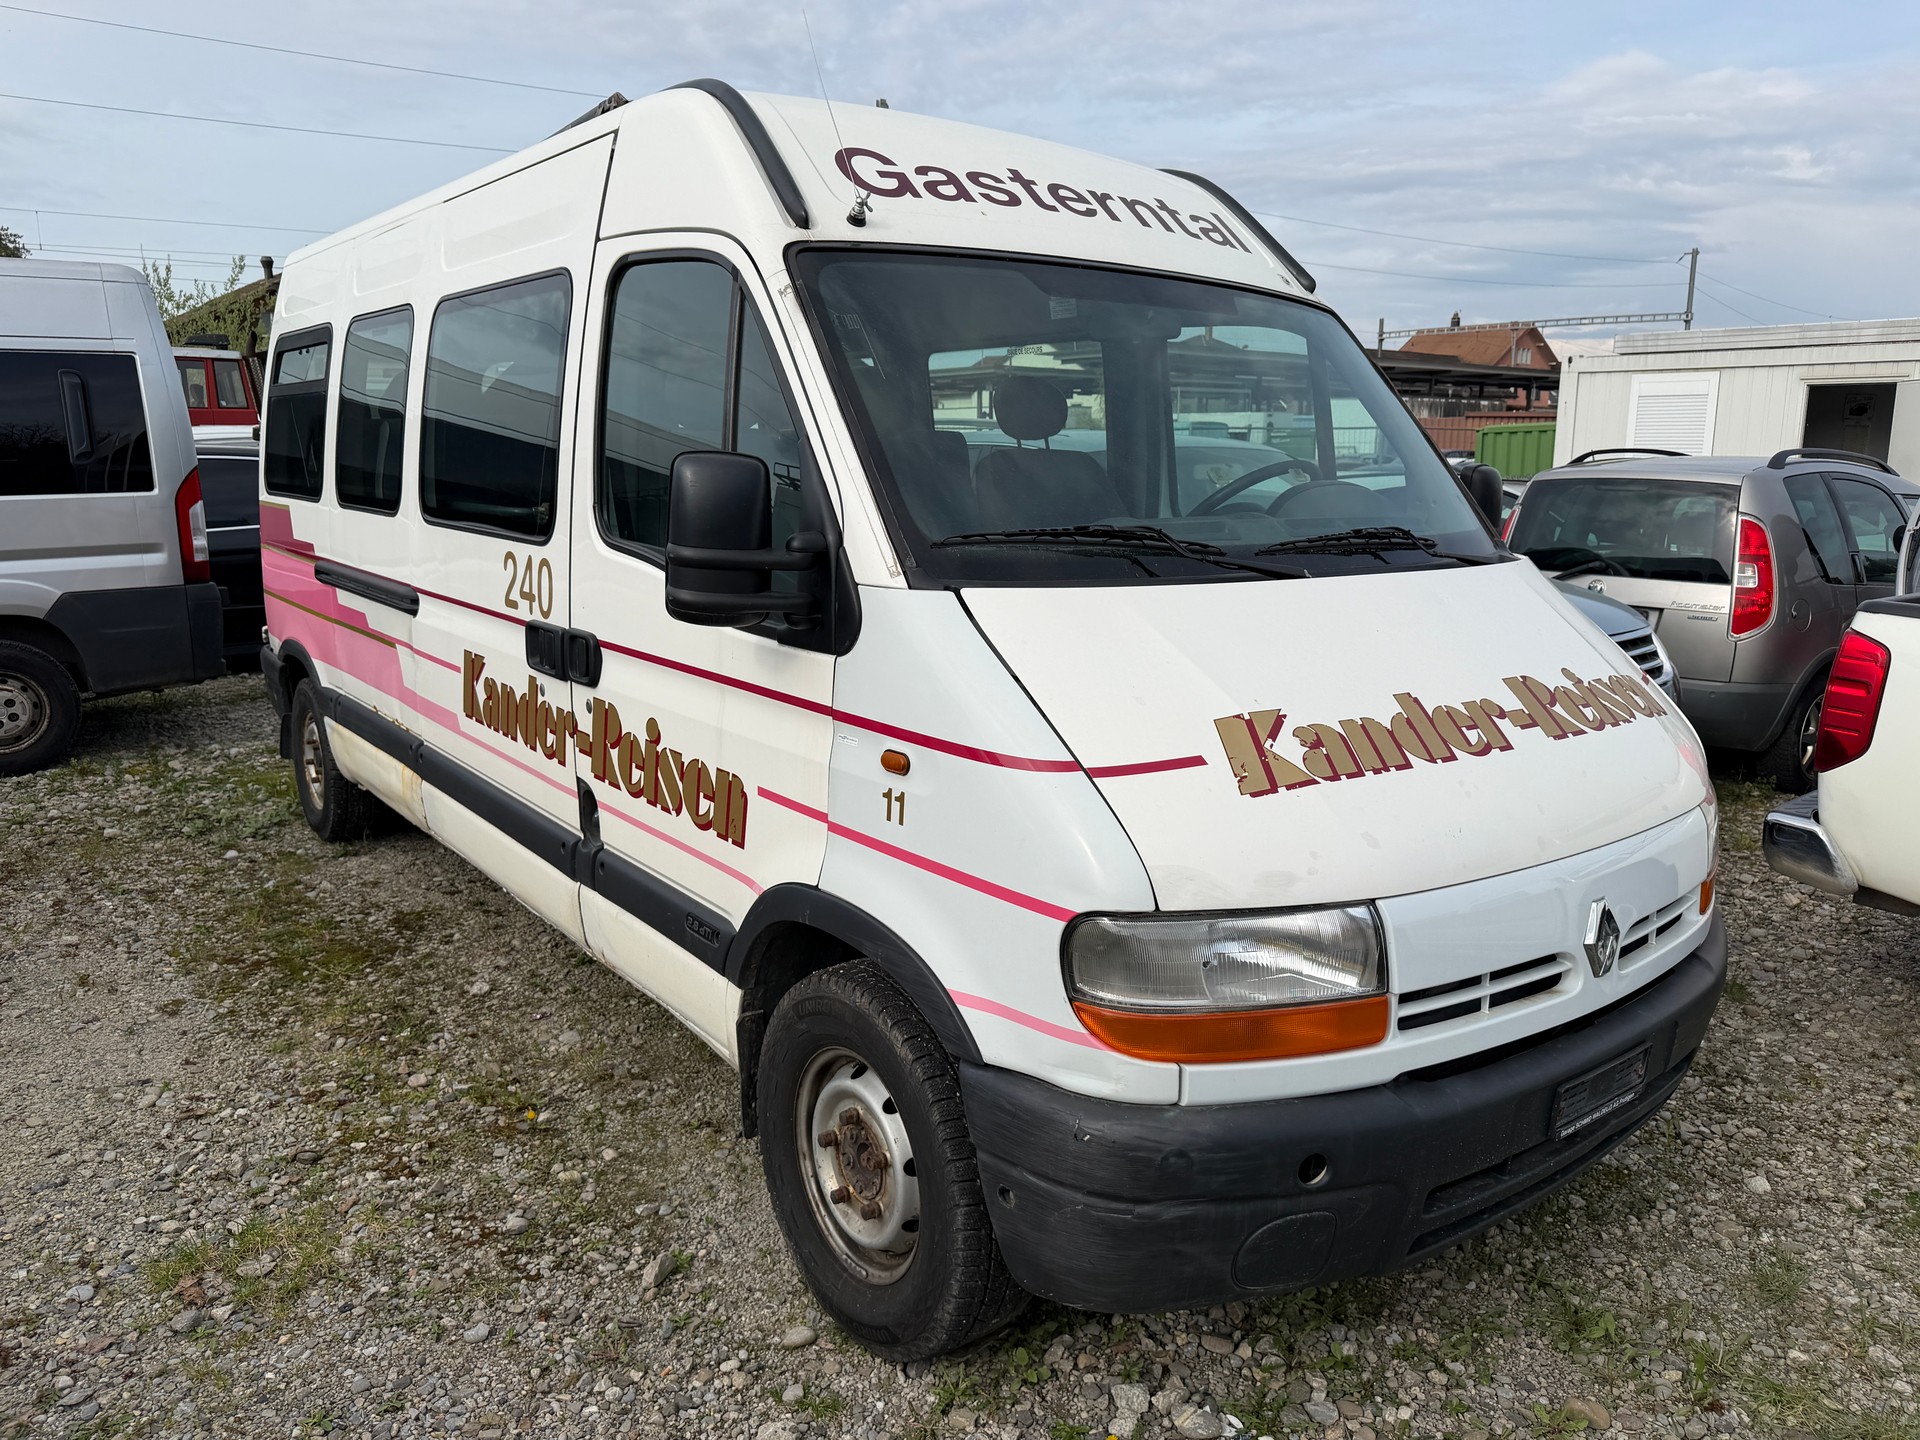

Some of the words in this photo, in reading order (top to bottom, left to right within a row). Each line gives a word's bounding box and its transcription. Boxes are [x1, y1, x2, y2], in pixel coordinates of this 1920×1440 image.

[834, 147, 1252, 254] Gasterntal
[503, 550, 554, 620] 240
[1670, 600, 1726, 611] Roomster
[463, 649, 748, 850] Kander-Reisen
[1213, 668, 1668, 798] Kander-Reisen
[882, 787, 905, 826] 11
